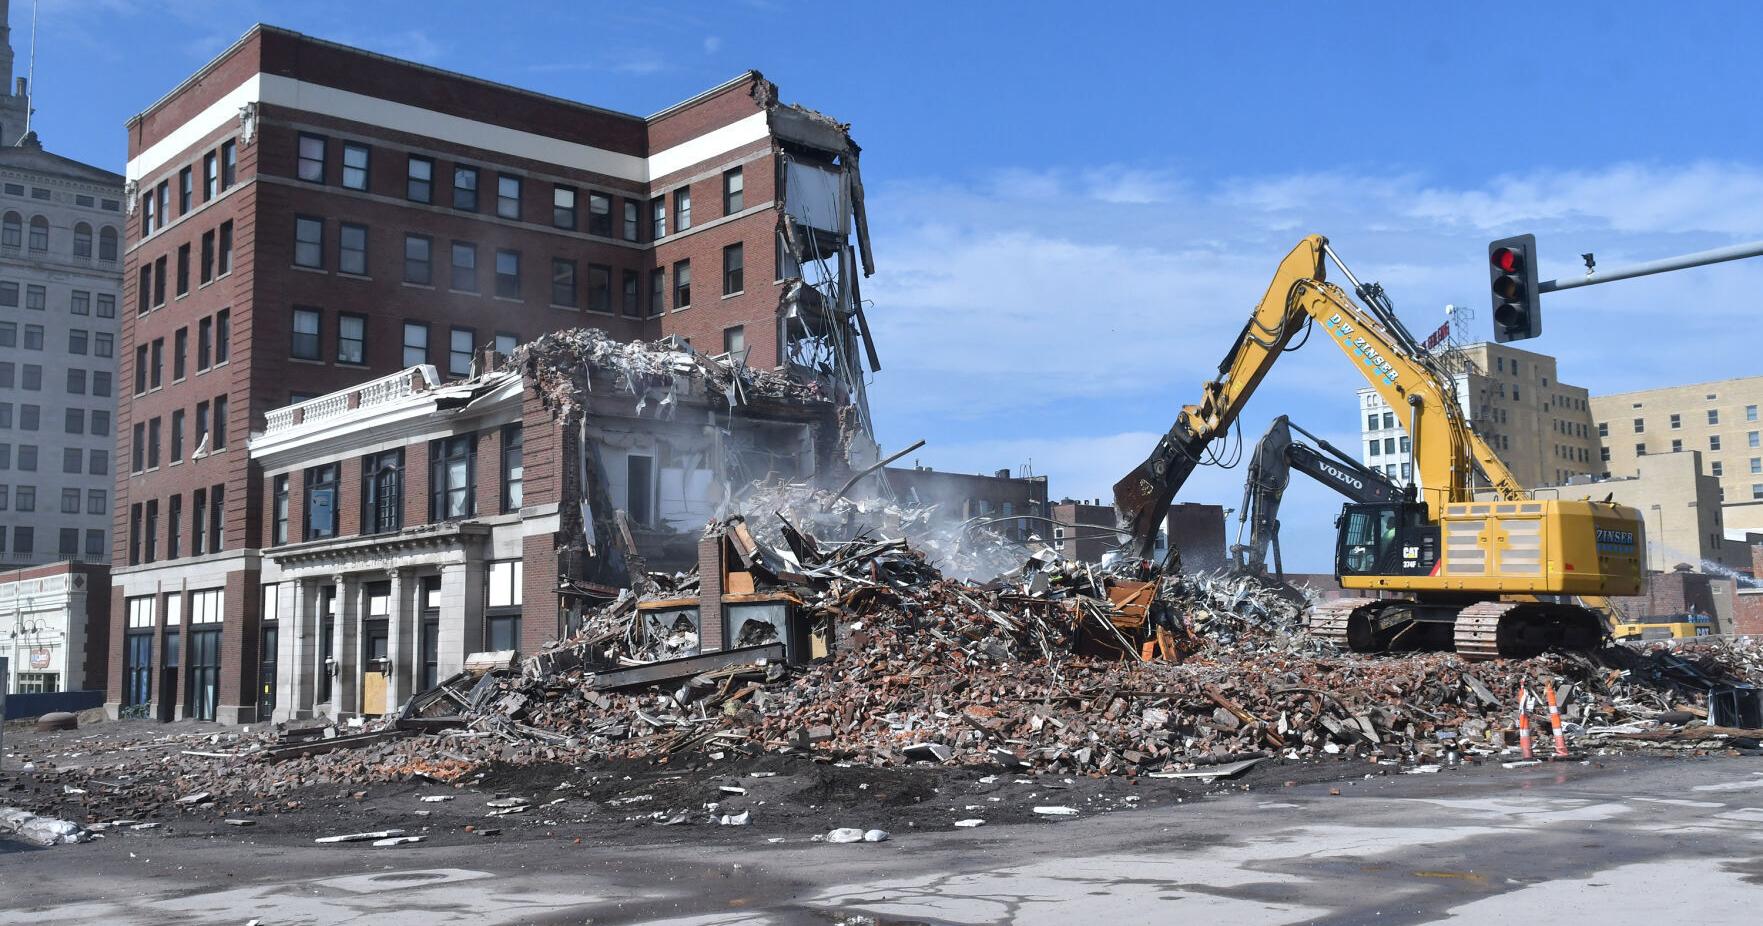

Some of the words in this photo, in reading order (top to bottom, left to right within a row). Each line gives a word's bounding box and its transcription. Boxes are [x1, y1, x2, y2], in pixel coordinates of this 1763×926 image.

[1353, 337, 1399, 381] ZINSER
[1318, 460, 1363, 490] VOLVO
[1596, 529, 1633, 545] ZINSER
[1402, 546, 1419, 559] CAT
